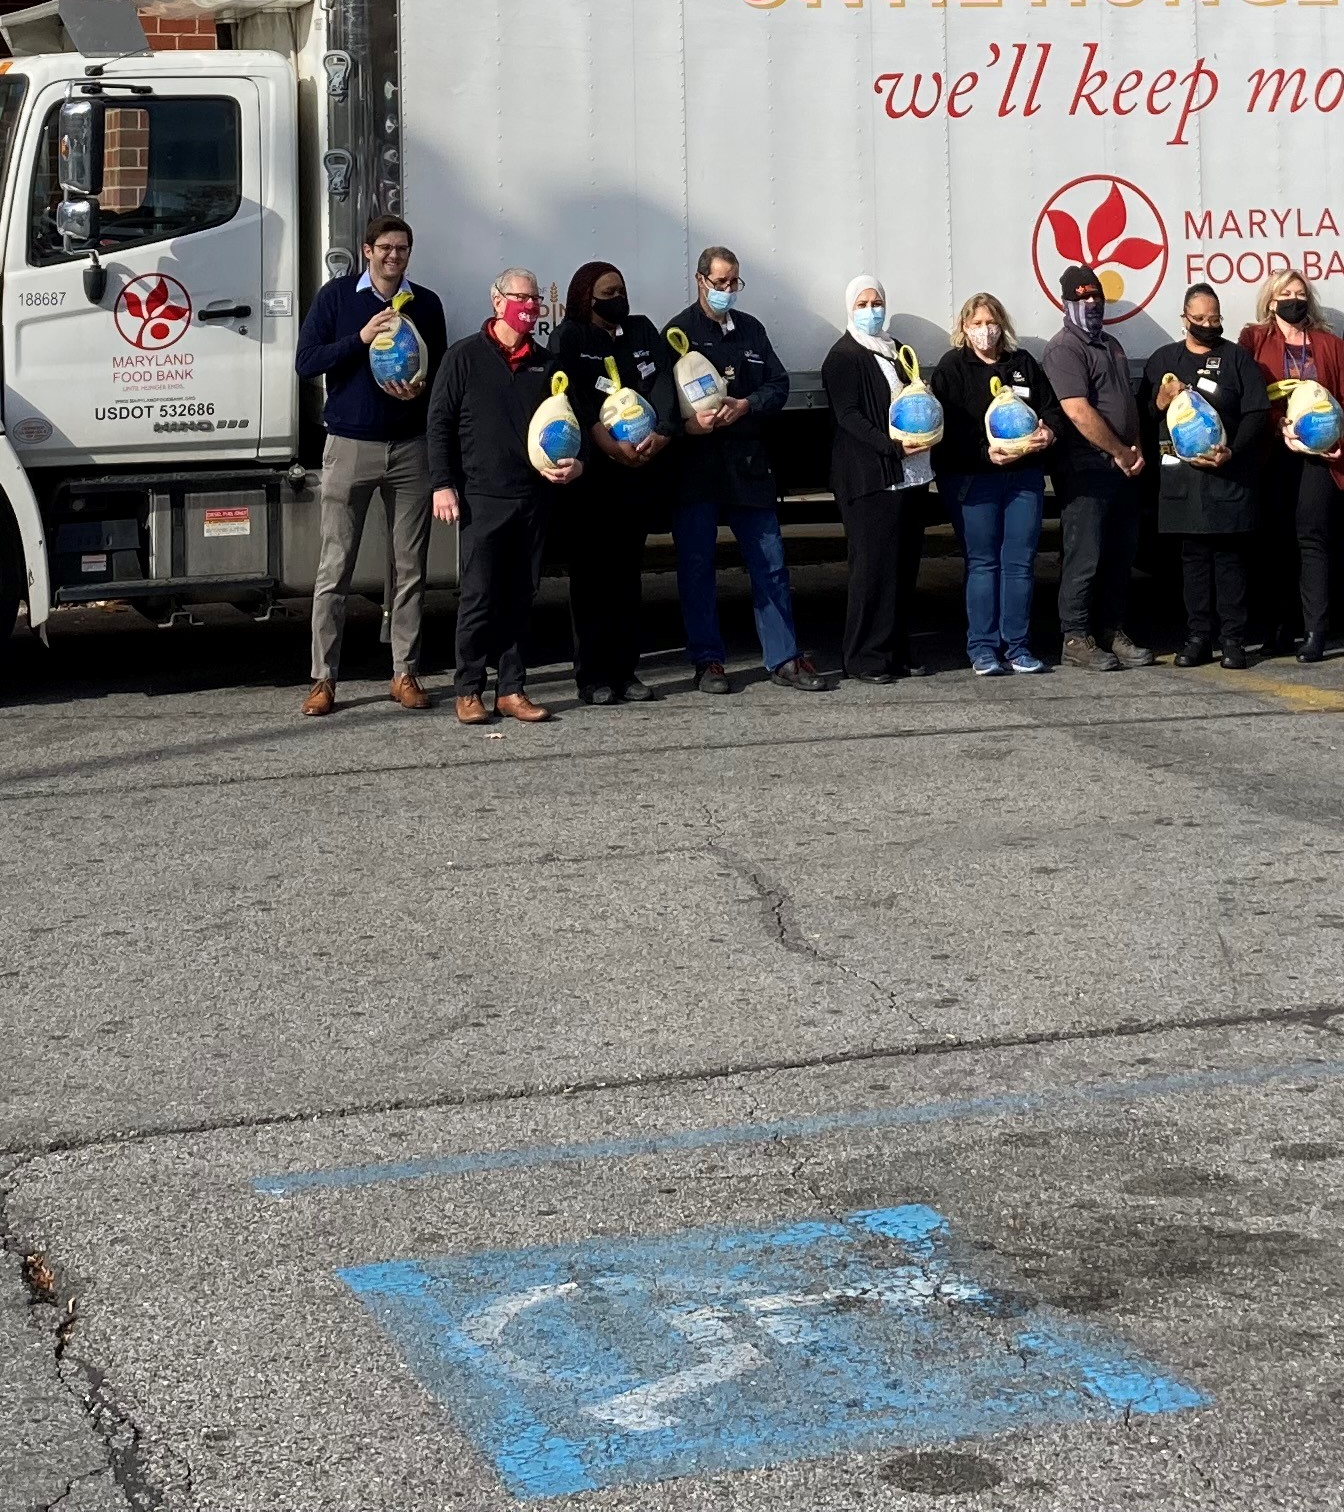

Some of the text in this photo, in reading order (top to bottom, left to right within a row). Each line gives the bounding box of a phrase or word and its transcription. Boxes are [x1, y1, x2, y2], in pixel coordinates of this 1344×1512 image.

[873, 42, 1049, 121] we'll
[1068, 42, 1220, 147] keep
[1186, 251, 1291, 285] FOOD
[18, 291, 67, 307] 188687
[112, 353, 194, 369] MARYLAND
[112, 368, 194, 383] FOOD BANK
[95, 402, 215, 421] USDOT 532686
